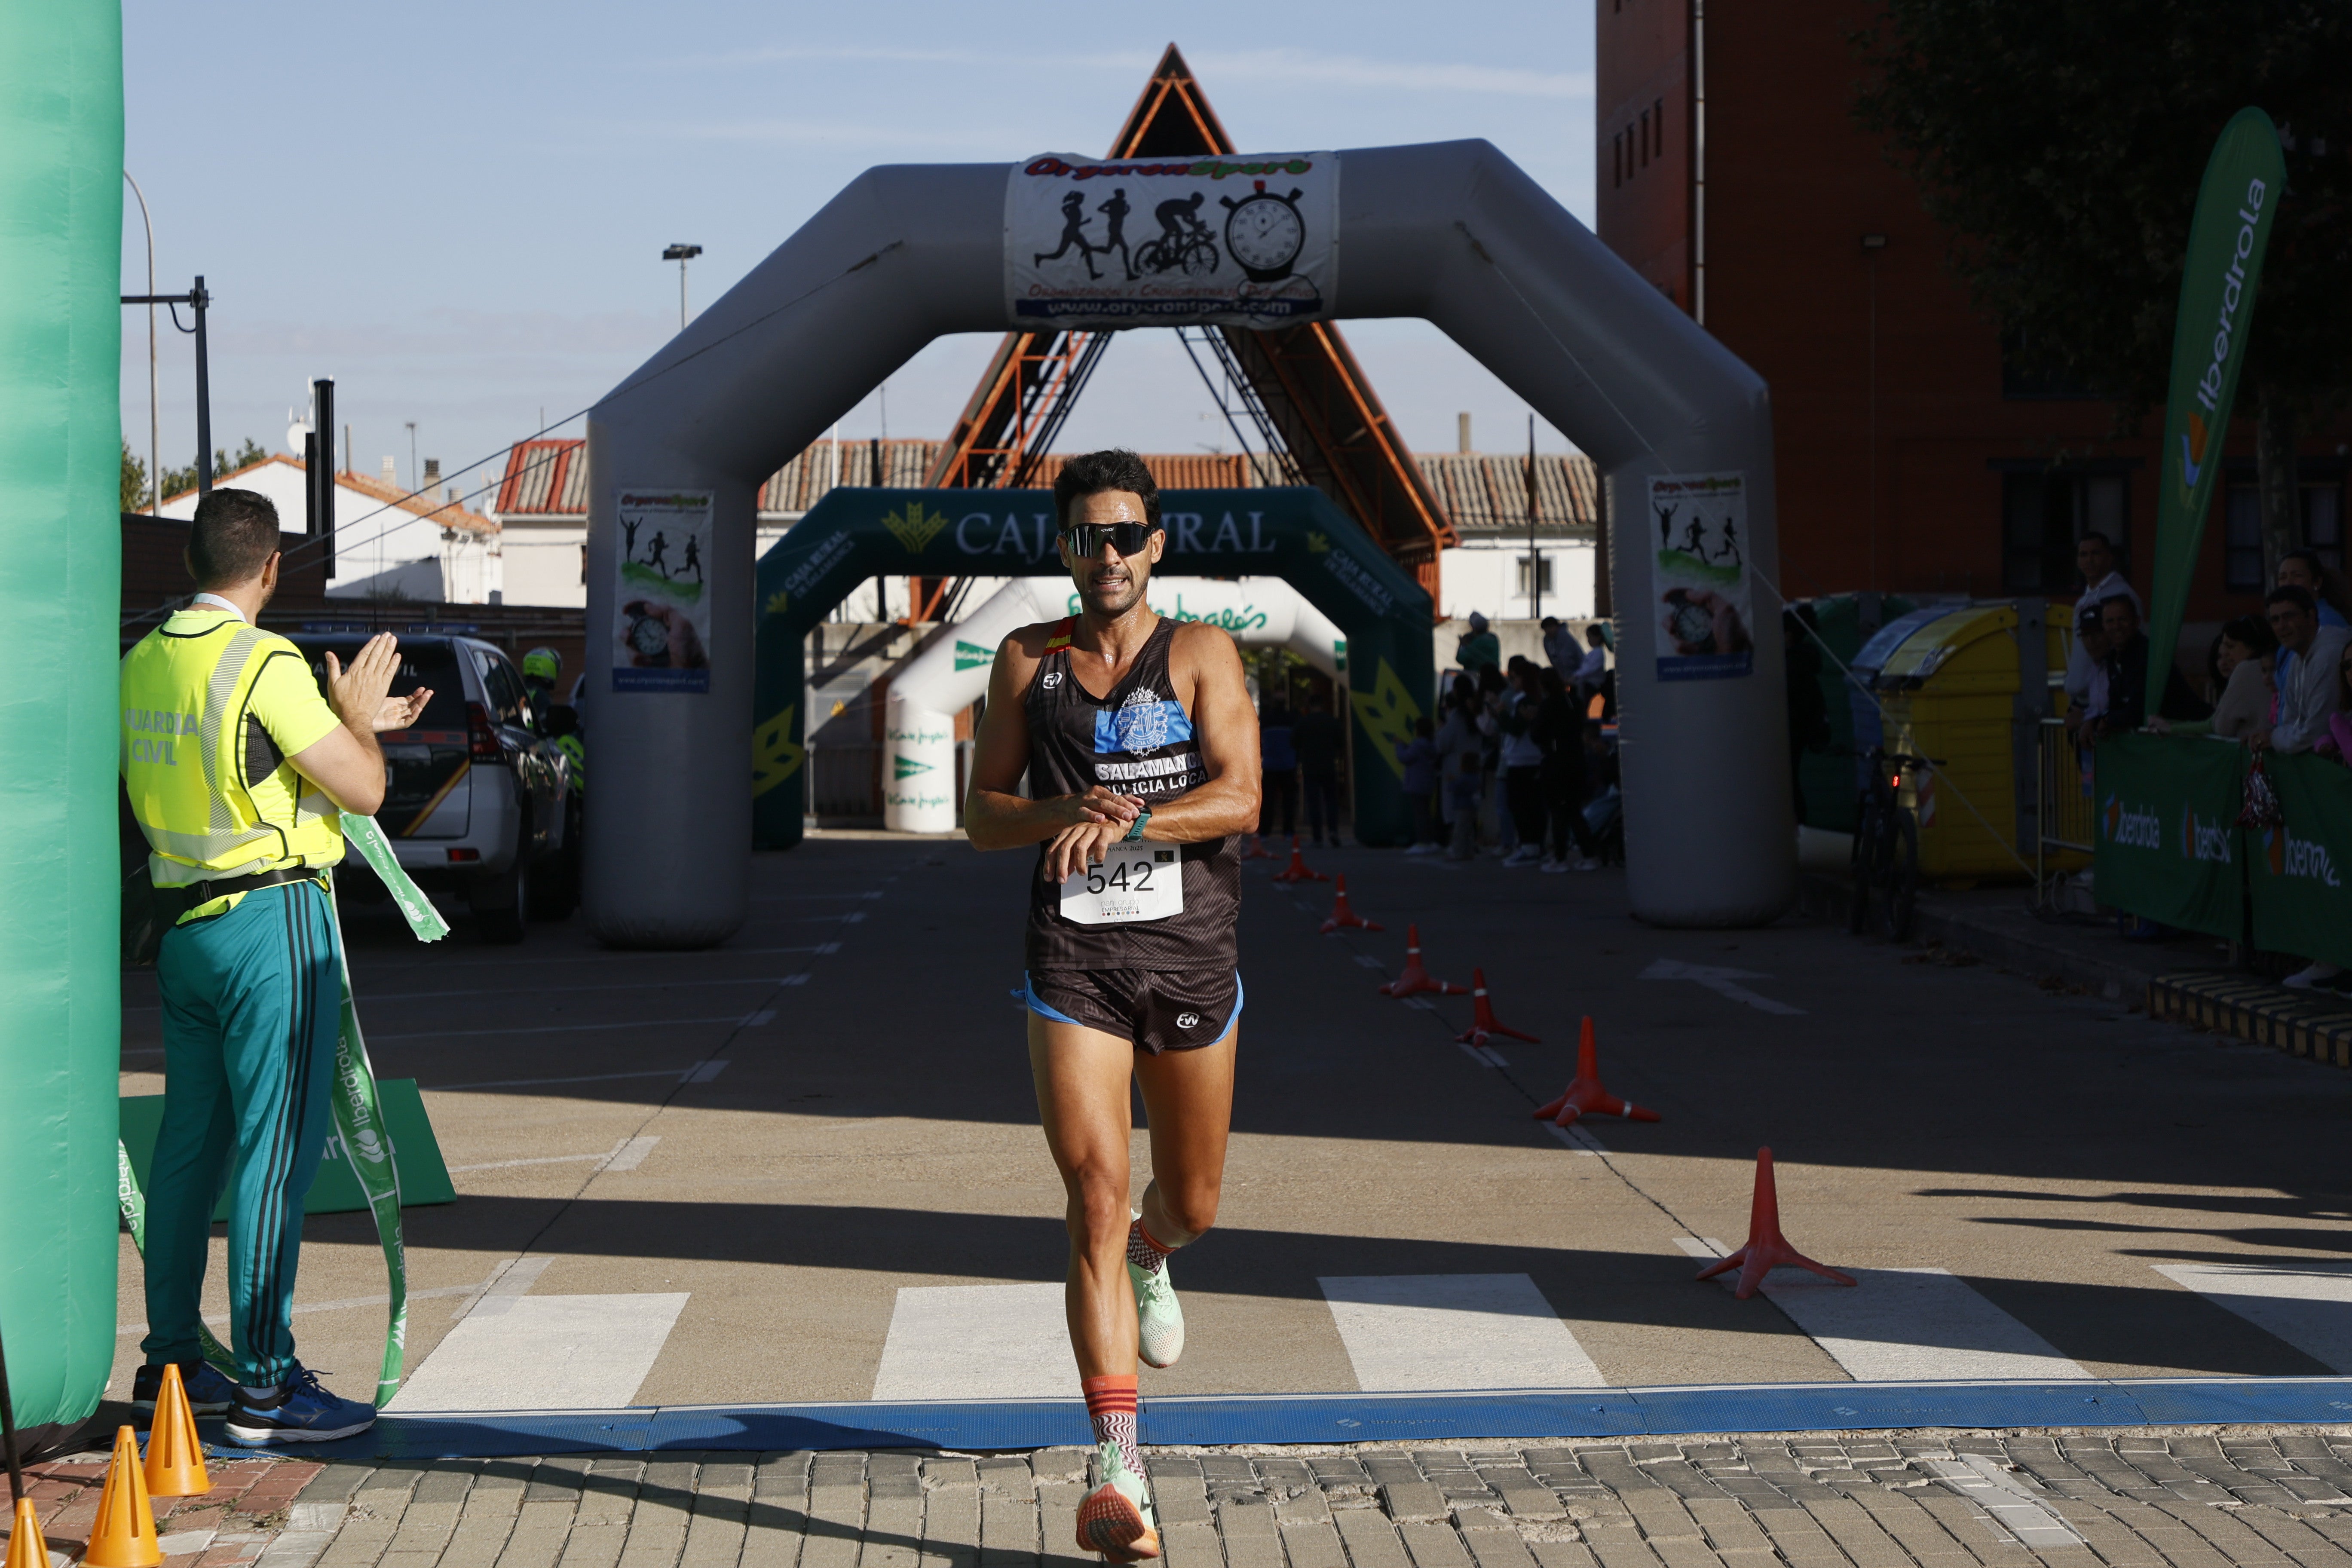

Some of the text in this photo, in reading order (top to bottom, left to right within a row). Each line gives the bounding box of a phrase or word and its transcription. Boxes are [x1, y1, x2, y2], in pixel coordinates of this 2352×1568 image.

[1025, 157, 1312, 180] OrycronSport
[2197, 178, 2266, 412] Iberdrola
[1161, 511, 1277, 554] RAL
[132, 738, 178, 766] CIVIL
[1126, 732, 1161, 746] POLICIA LOCAL
[1169, 769, 1212, 790] LOCA
[1087, 861, 1154, 894] 542
[1101, 899, 1116, 907] nani
[336, 1036, 371, 1127] Iberdrola
